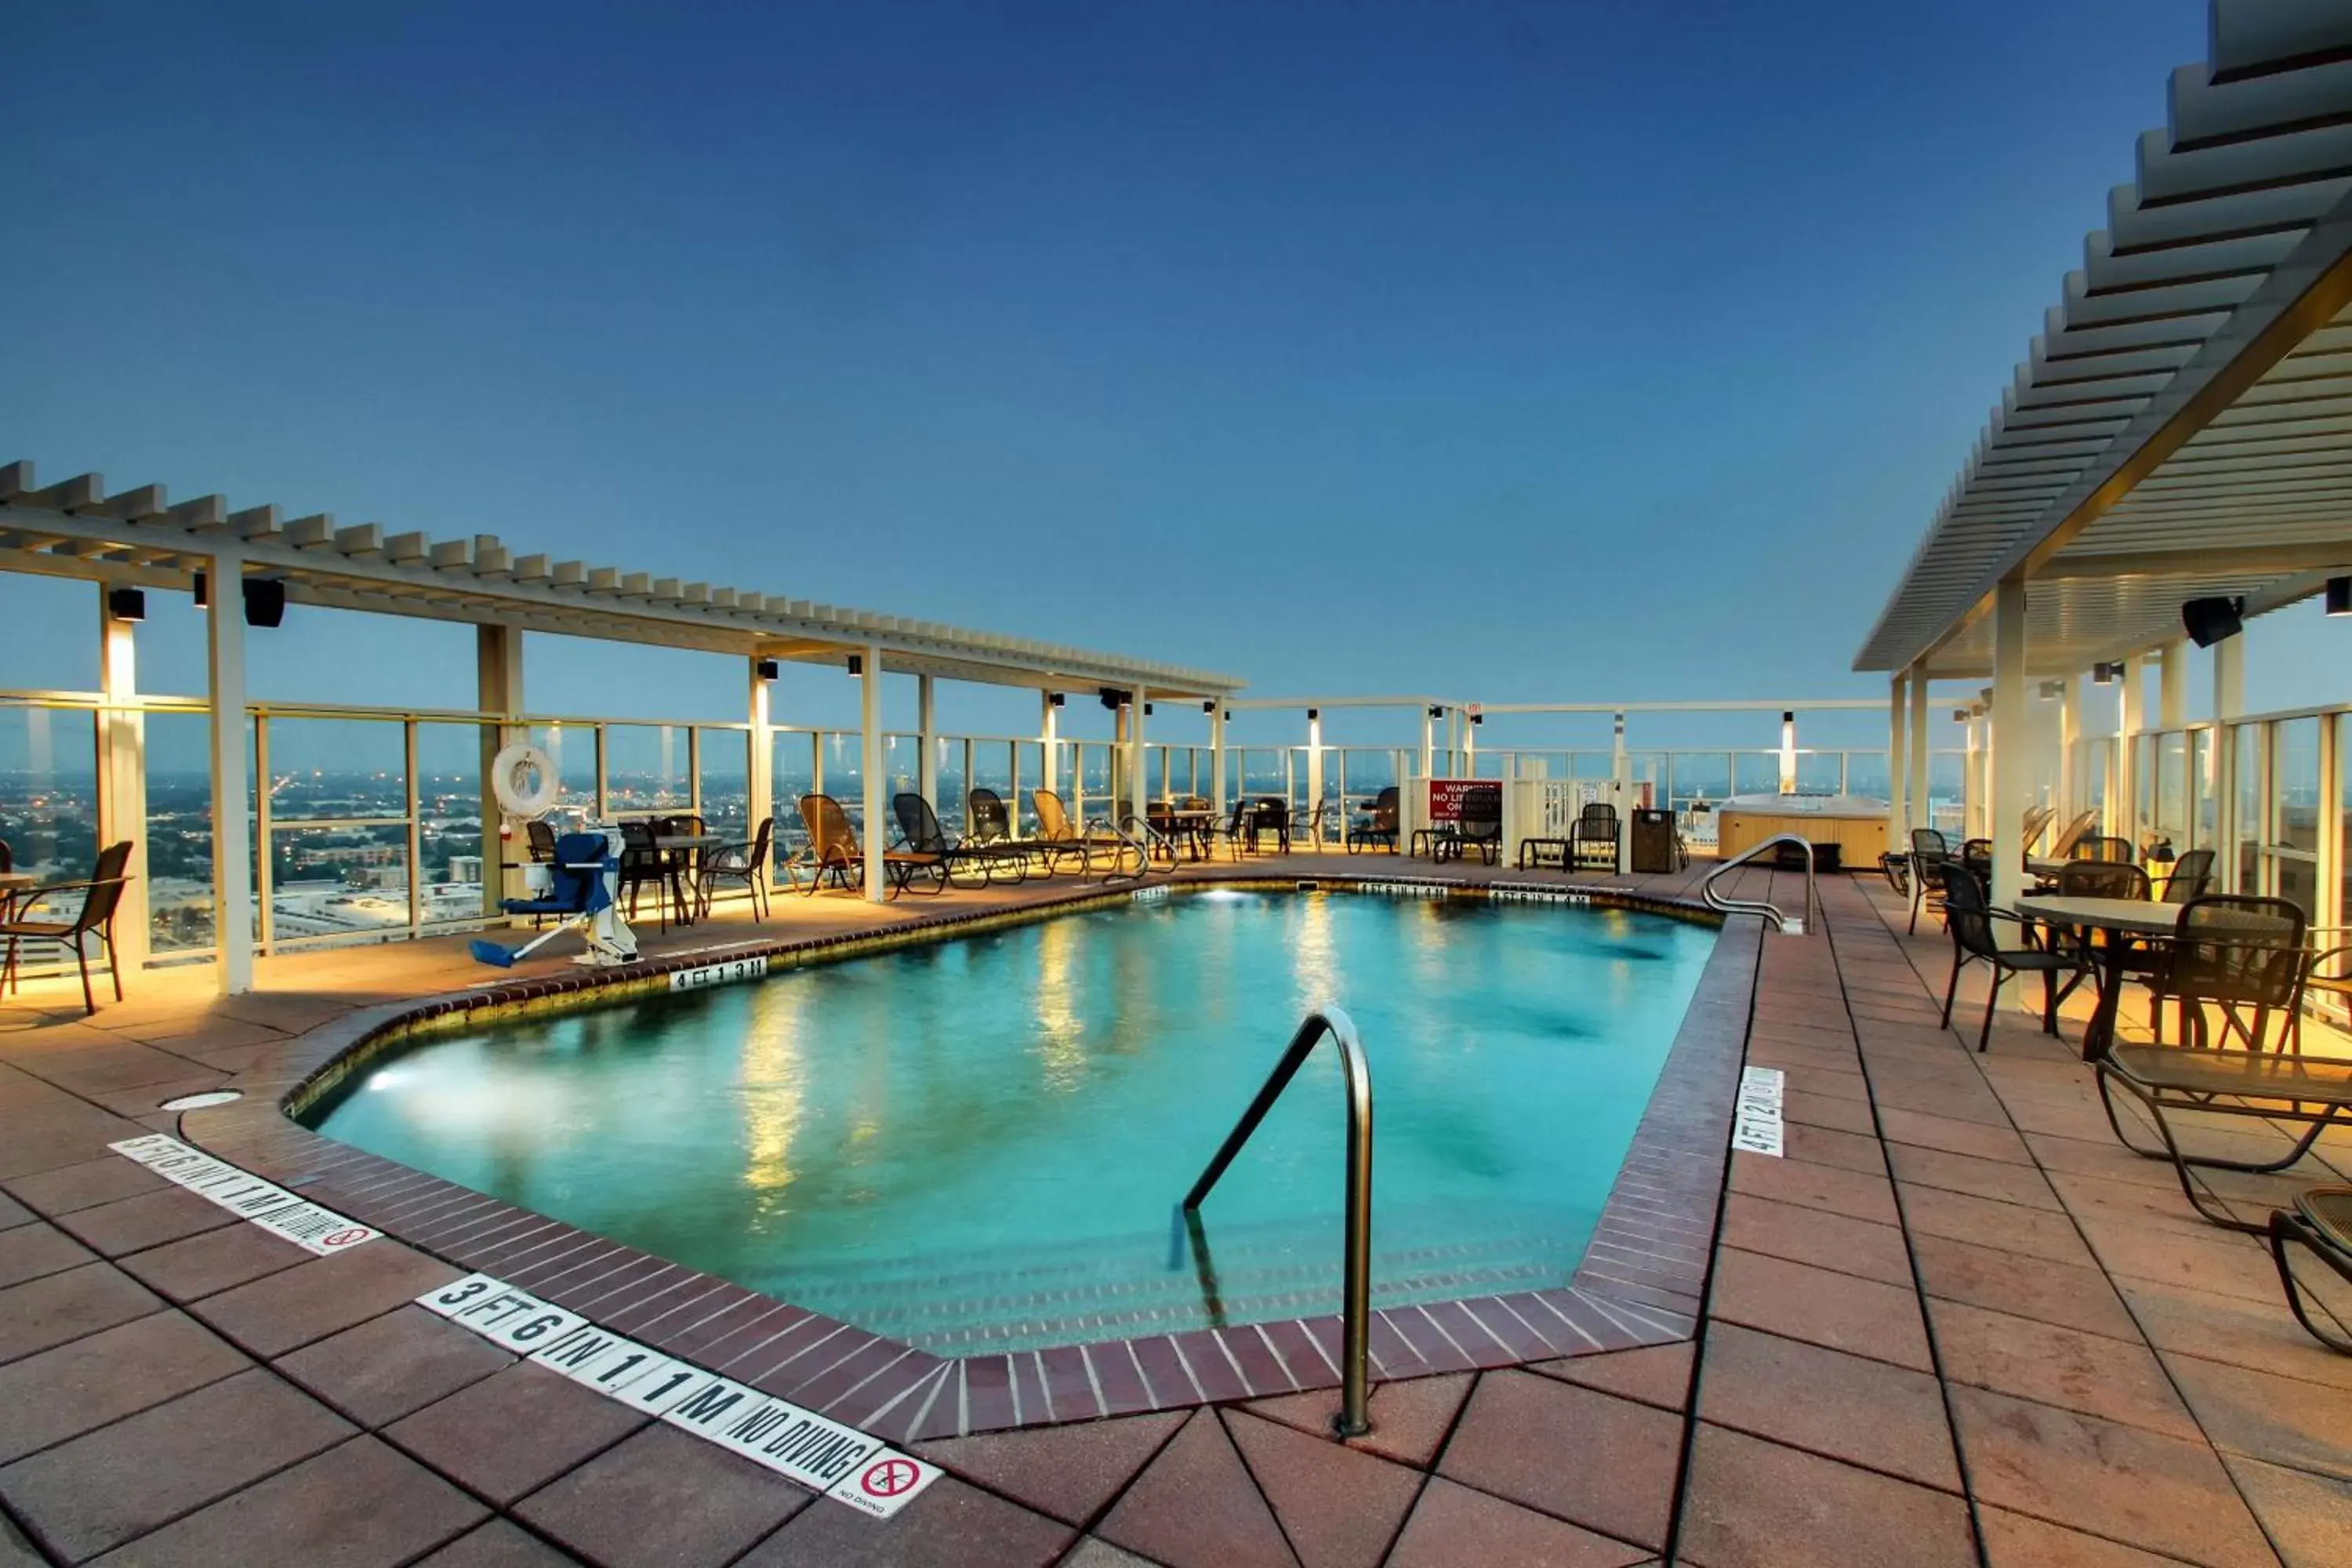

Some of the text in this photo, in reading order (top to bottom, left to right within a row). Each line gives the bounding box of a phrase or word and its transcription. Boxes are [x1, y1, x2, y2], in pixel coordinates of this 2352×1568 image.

[1451, 793, 1500, 802] LIFEGUAR
[692, 969, 710, 985] FT
[438, 1282, 488, 1304] 3
[464, 1294, 537, 1326] FT
[512, 1314, 564, 1341] 6
[543, 1331, 614, 1367] IN
[676, 1384, 745, 1425] M
[726, 1405, 790, 1443] NO
[761, 1420, 867, 1479] DIVING
